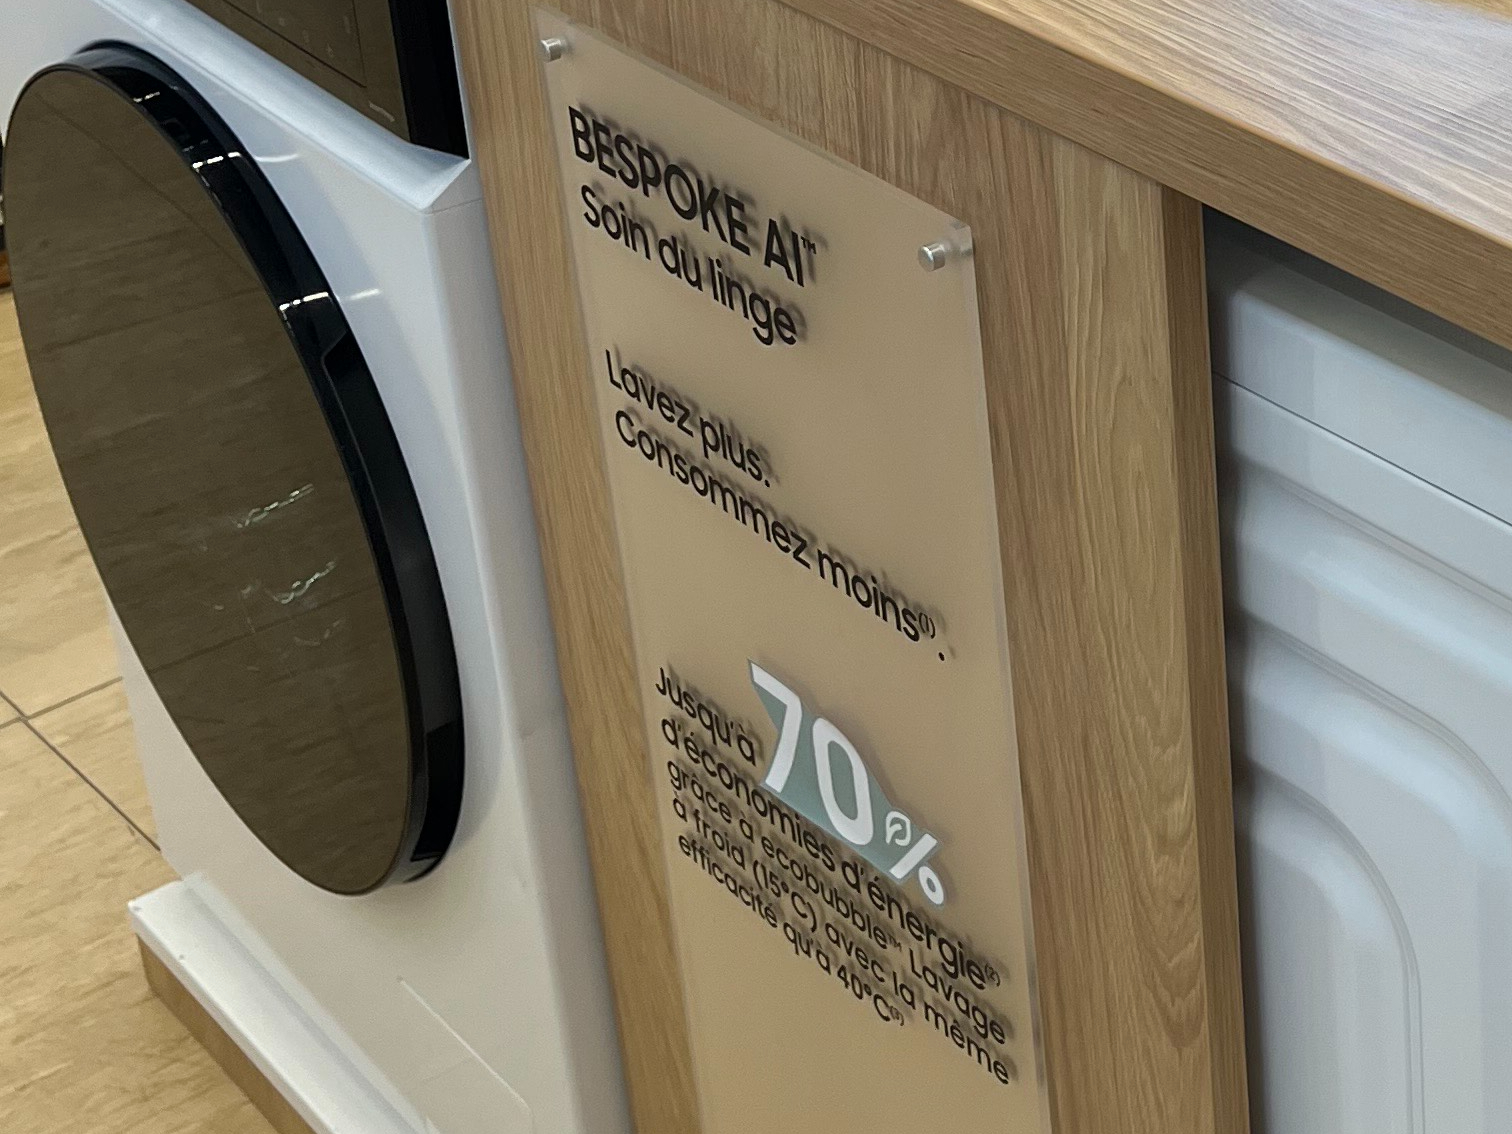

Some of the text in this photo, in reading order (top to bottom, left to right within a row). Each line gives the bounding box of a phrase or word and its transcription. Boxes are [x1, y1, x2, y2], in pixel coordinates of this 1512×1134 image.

[567, 105, 752, 257] BESPOKE
[580, 184, 798, 347] Soin du linge
[605, 348, 772, 489] Lavez plus.
[615, 409, 812, 571] Consommez
[655, 667, 758, 767] Jusqu'à
[660, 716, 837, 873] d'économies
[666, 759, 733, 823] grâce
[738, 810, 756, 844] à
[908, 948, 1007, 1047] Lavage
[672, 790, 1010, 1087] à froid (15°C) avec la même
[678, 831, 779, 930] efficacité
[782, 919, 833, 975] qu'à
